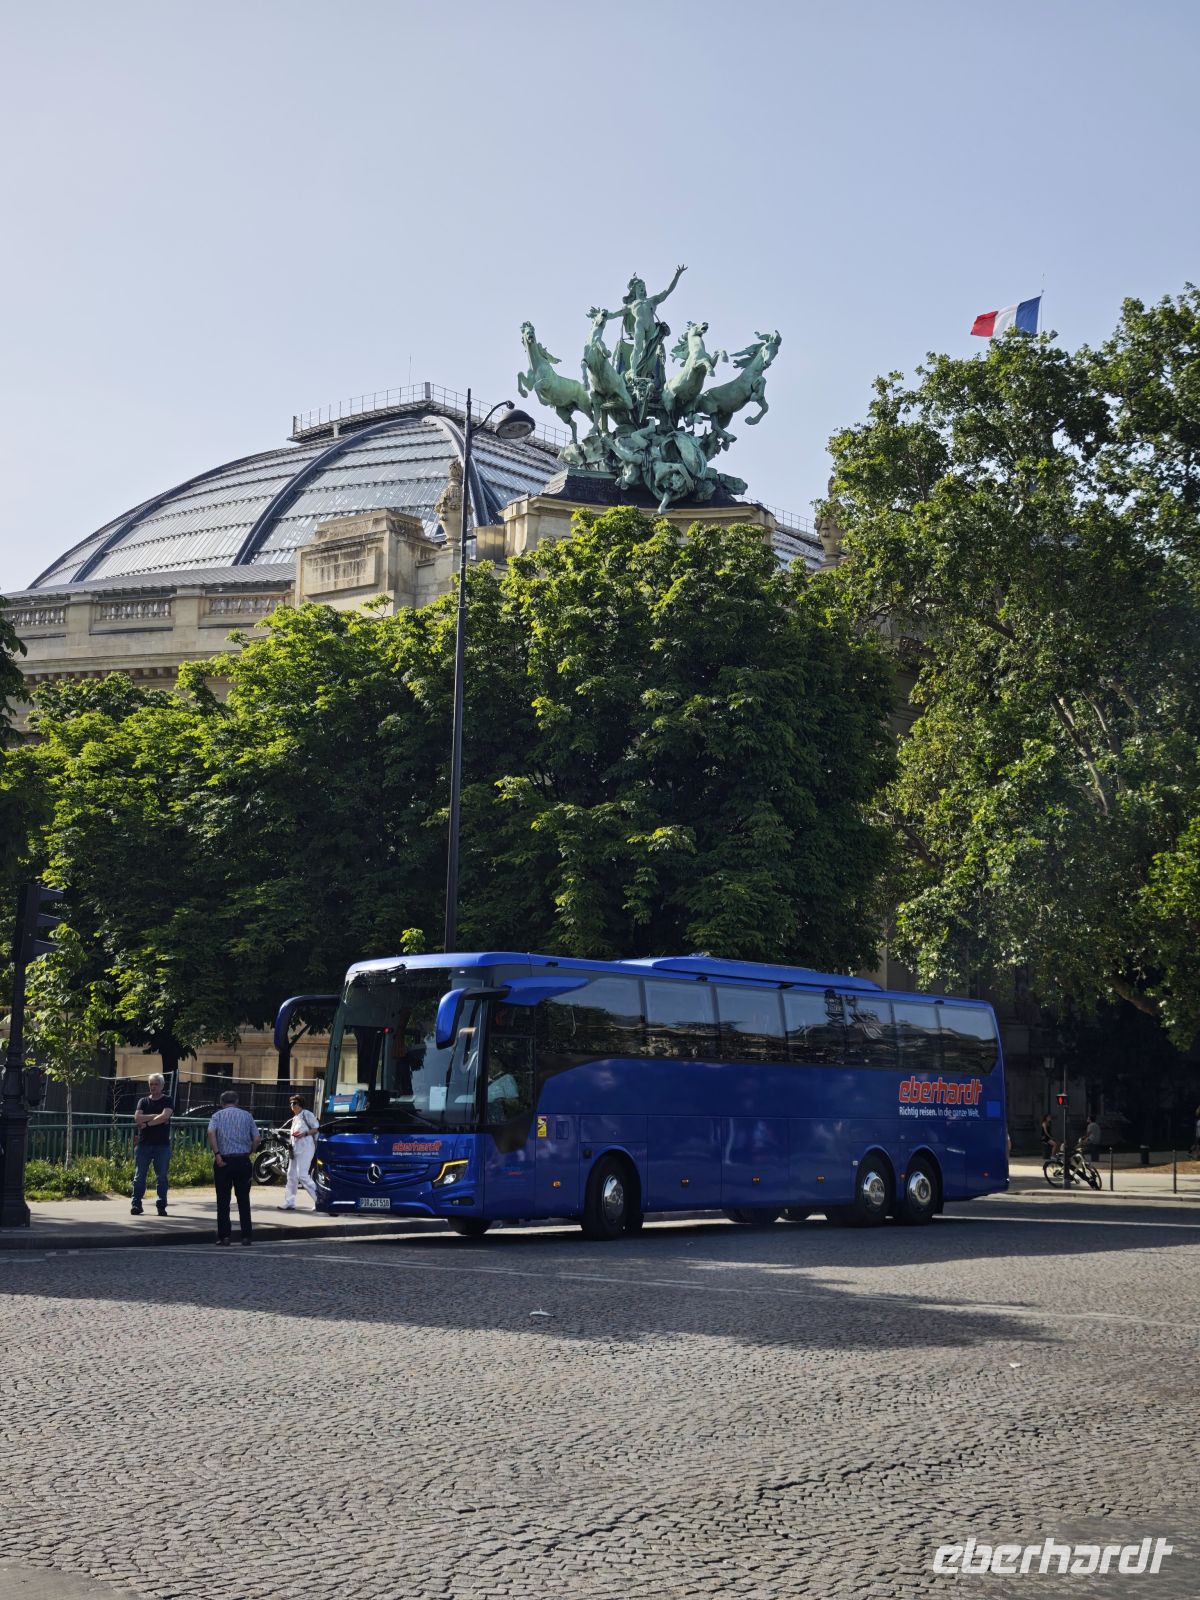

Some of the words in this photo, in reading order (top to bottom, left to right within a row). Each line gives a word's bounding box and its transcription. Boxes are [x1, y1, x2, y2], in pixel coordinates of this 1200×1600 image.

[899, 1075, 983, 1105] eberhardt
[899, 1106, 919, 1118] Richtig
[920, 1107, 937, 1116] reisen.
